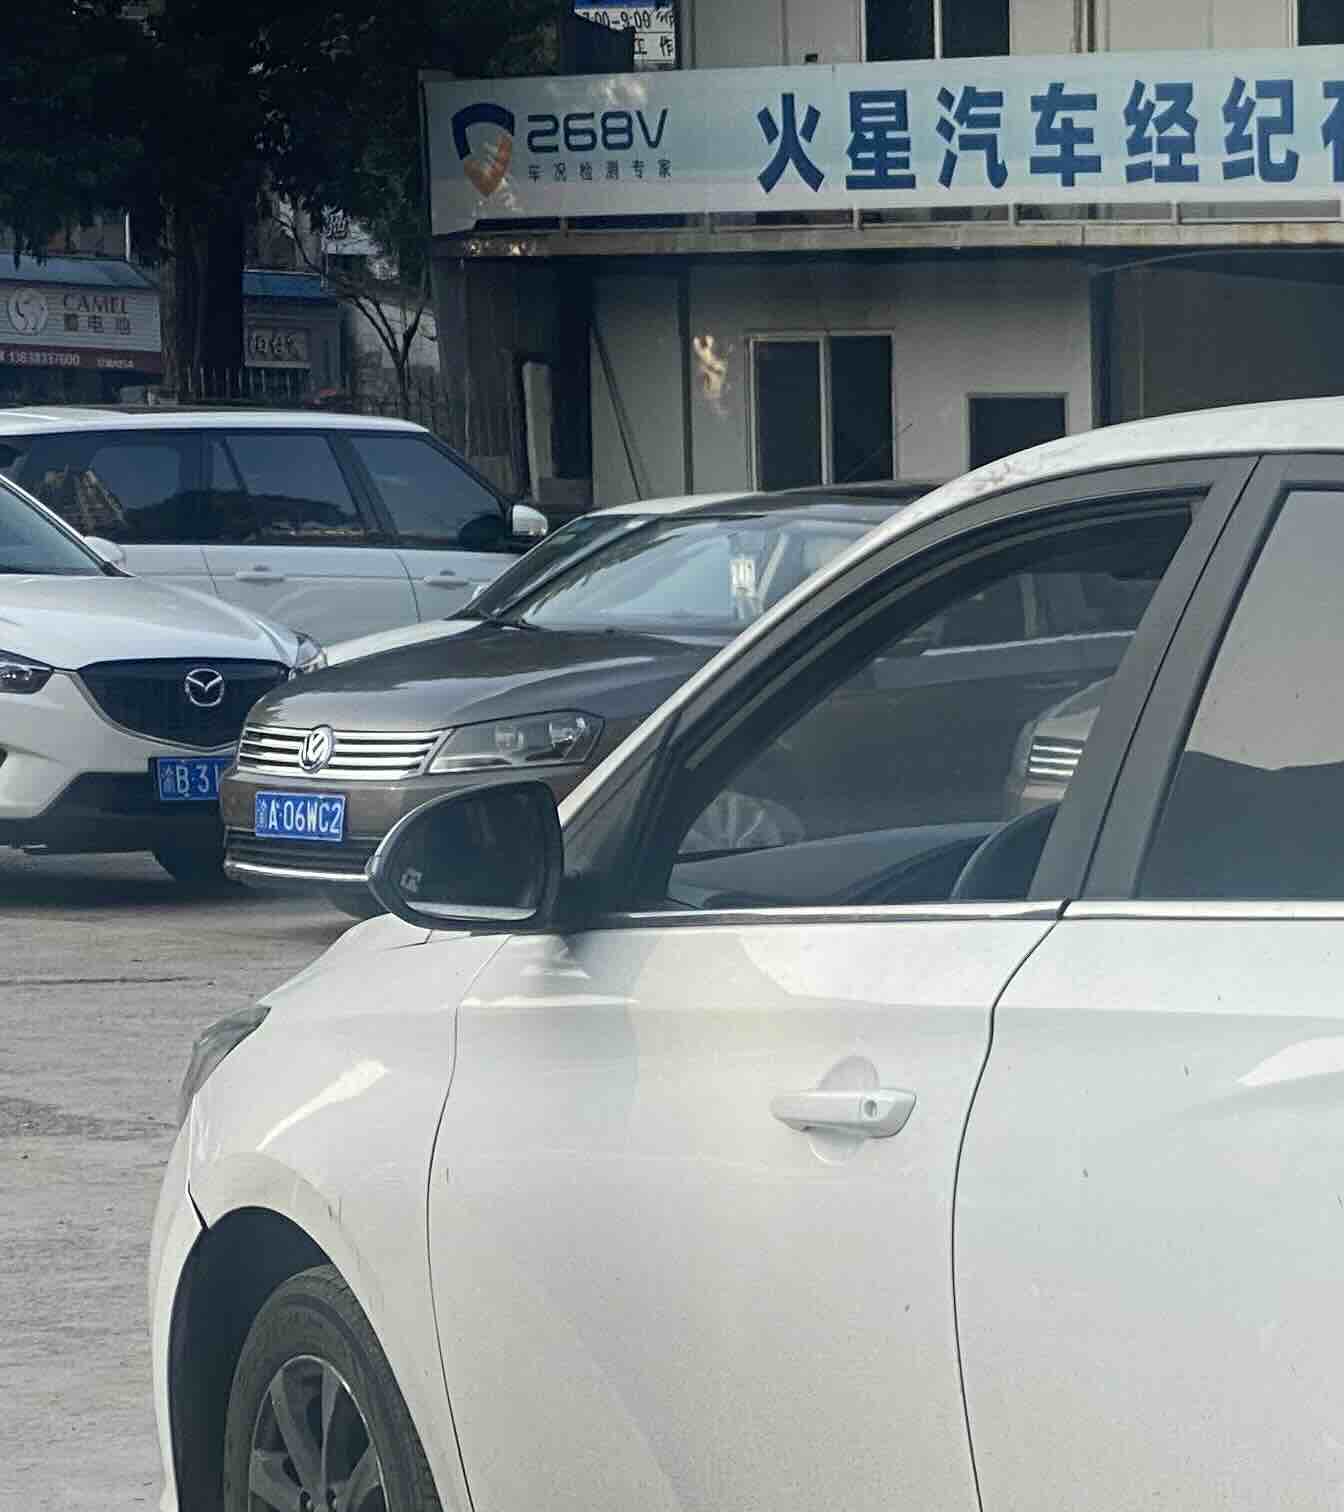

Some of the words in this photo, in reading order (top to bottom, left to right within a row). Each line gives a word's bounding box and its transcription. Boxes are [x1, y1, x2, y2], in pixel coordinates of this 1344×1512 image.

[526, 106, 669, 153] 268V
[527, 159, 673, 181] 车况检测专家
